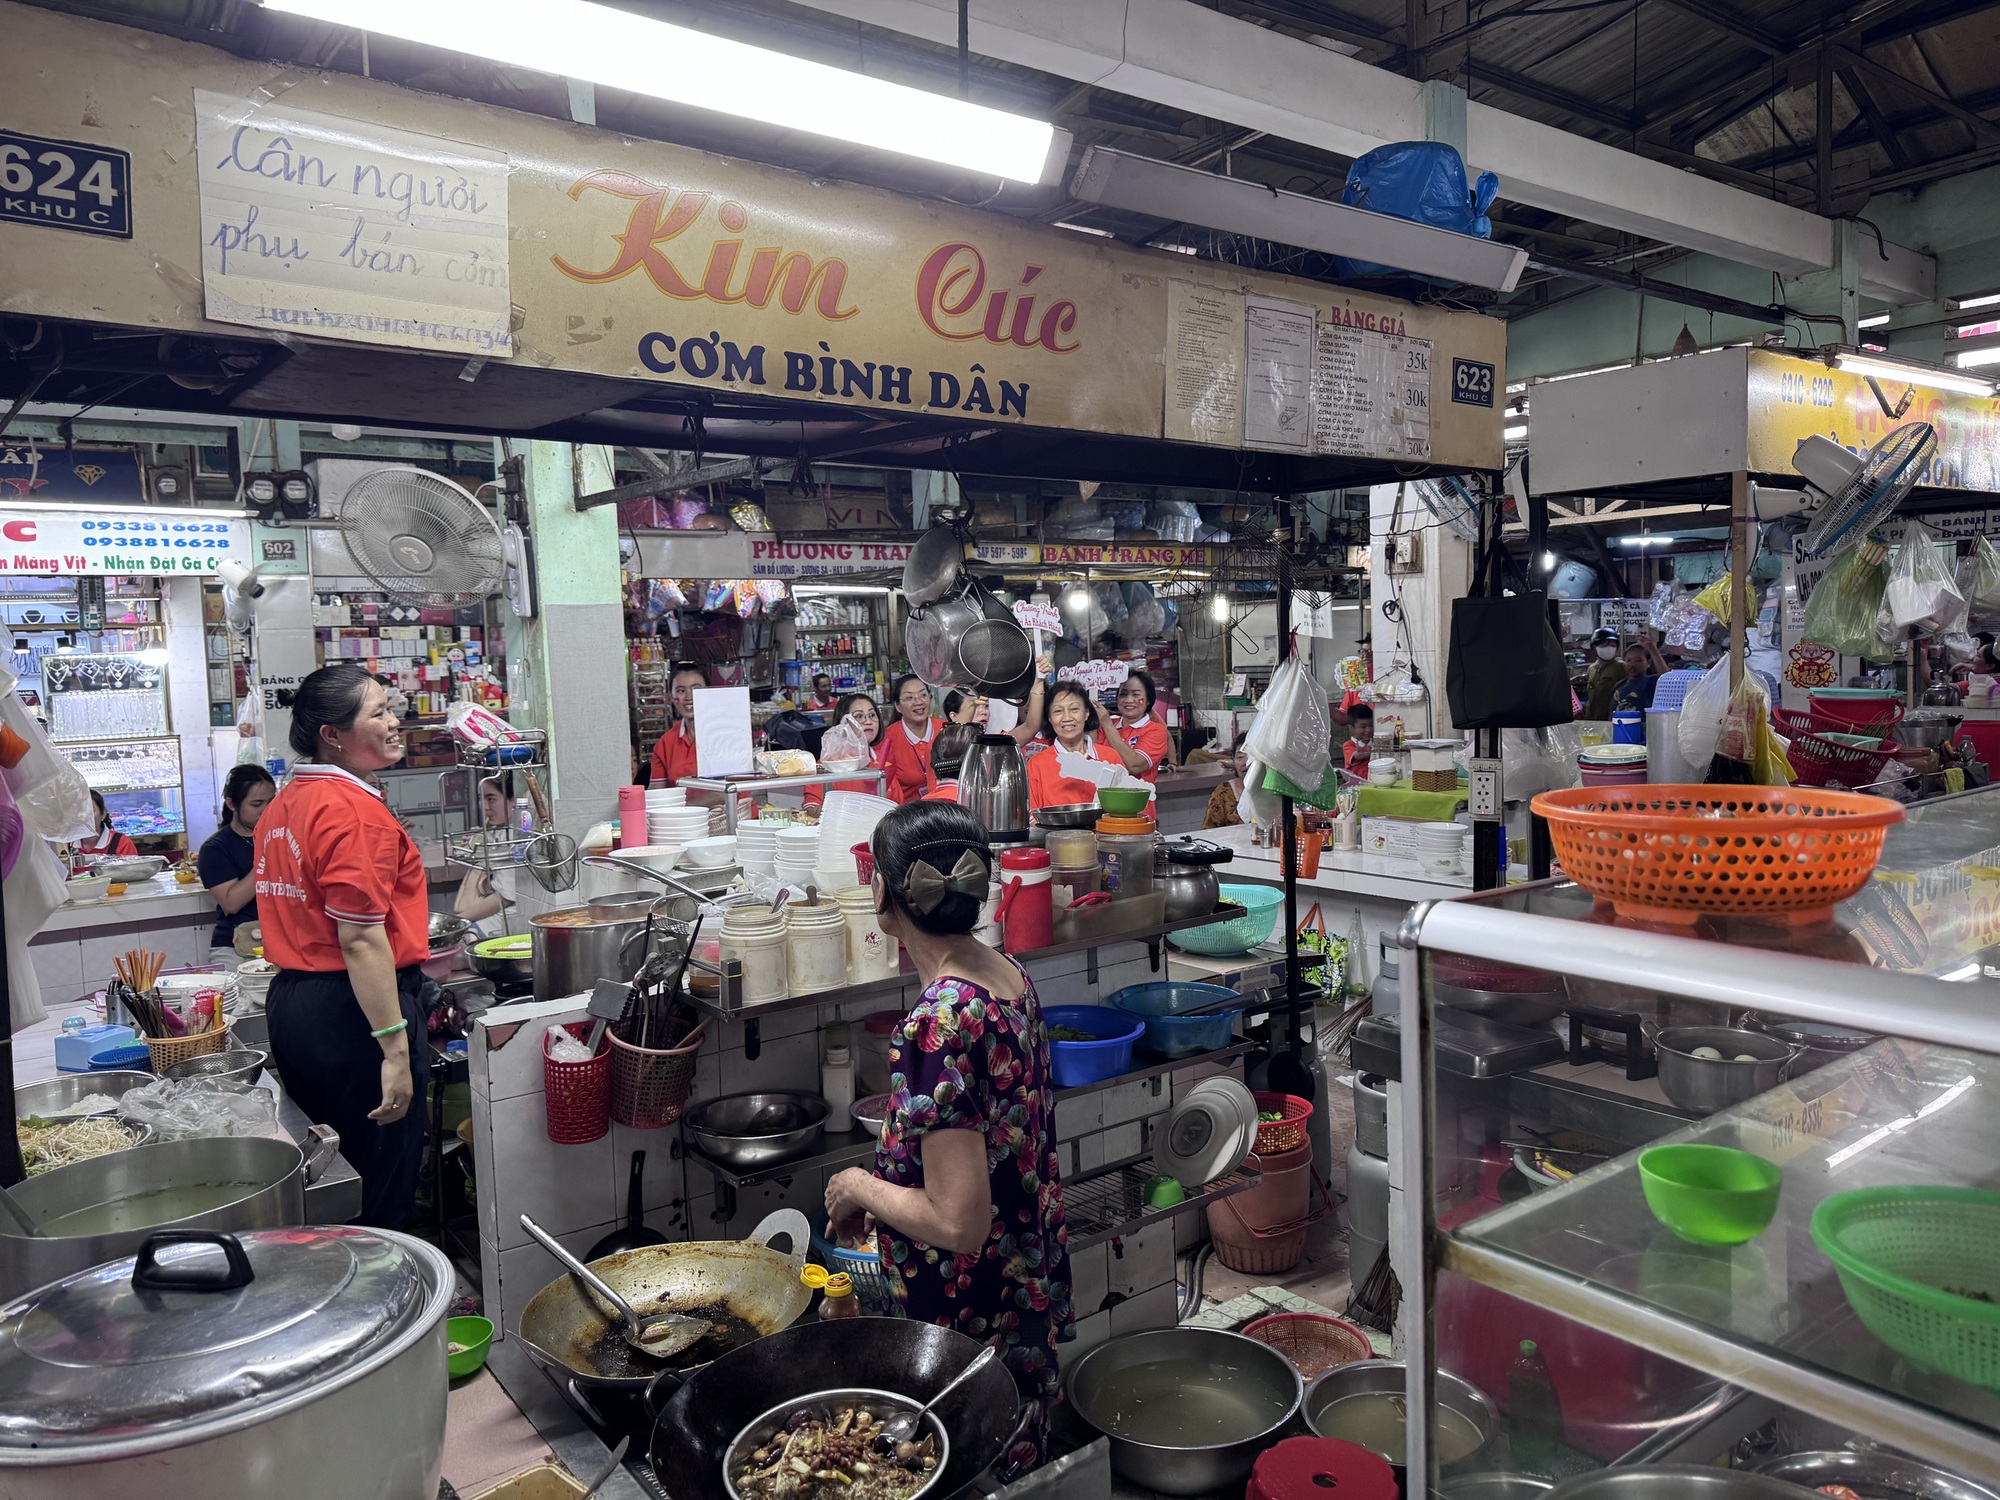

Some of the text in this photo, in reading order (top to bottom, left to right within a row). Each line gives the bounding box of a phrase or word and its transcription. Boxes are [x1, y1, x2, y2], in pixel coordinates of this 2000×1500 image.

[0, 144, 118, 207] 624
[5, 197, 110, 224] KHU C
[210, 205, 309, 276] phụ
[338, 215, 425, 277] bán
[551, 168, 1082, 354] Kim Cúc
[1331, 298, 1407, 337] BẢNG GIÁ
[1407, 350, 1428, 370] 35k
[637, 331, 1031, 418] CƠM BÌNH DÂN
[1457, 365, 1491, 393] 623
[1406, 388, 1427, 408] 30k
[1459, 391, 1488, 402] KHU C
[1781, 373, 1834, 408] 621C 622C
[1407, 442, 1424, 456] 30k
[0, 520, 37, 542] C
[81, 520, 229, 533] 0933816628
[83, 536, 230, 548] 0938816628
[264, 542, 292, 554] 602
[13, 555, 60, 574] Măng
[63, 555, 87, 573] Vịt
[103, 555, 145, 574] Nhận
[150, 555, 177, 574] Đặt
[181, 555, 202, 571] Gà
[1044, 545, 1103, 564] BÁNH
[261, 675, 295, 685] BẢNG
